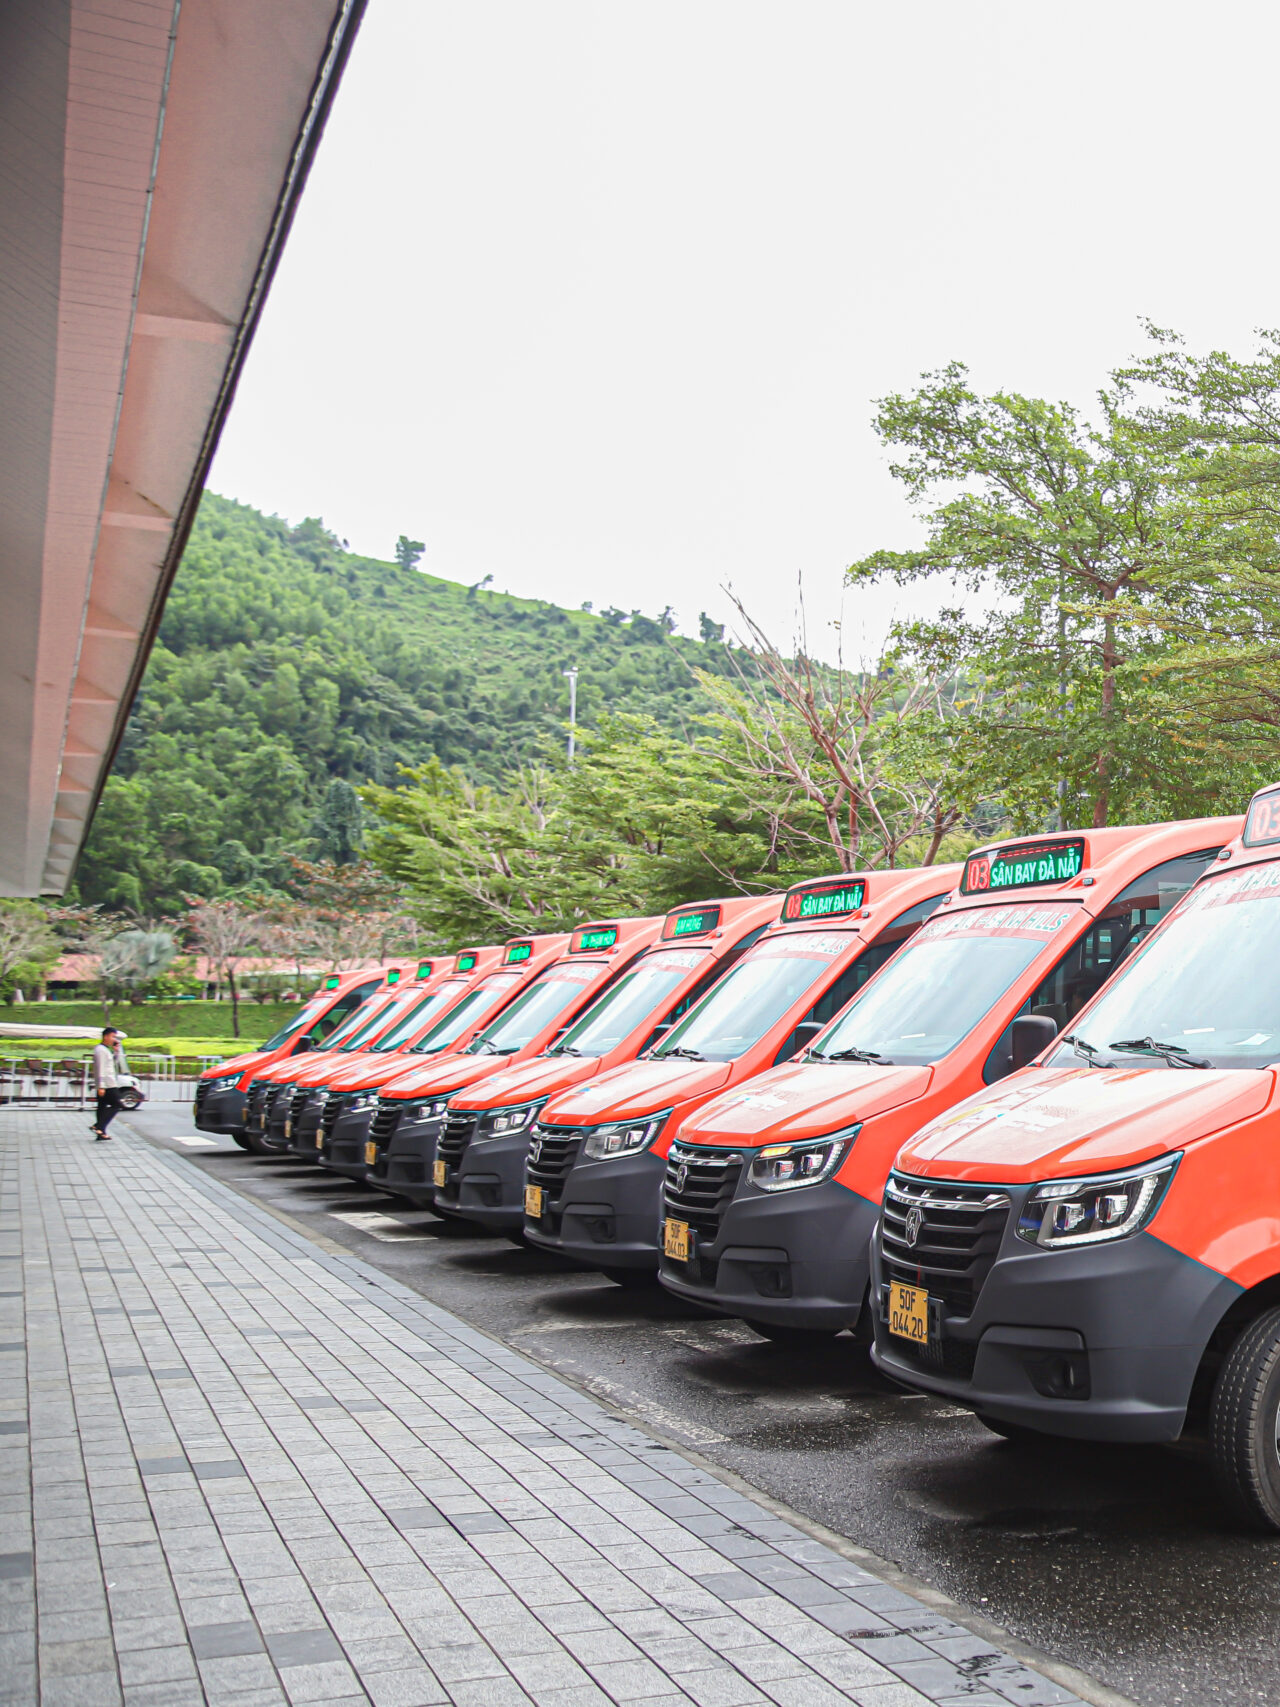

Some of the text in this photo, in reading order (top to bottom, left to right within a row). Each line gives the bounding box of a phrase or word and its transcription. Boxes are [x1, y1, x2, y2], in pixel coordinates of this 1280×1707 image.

[968, 861, 989, 890] 03
[990, 861, 1014, 888] SÂN
[1014, 862, 1037, 884] BAY
[1038, 854, 1056, 880] ĐÀ
[786, 894, 803, 919] 03
[801, 895, 818, 916] SÂN
[818, 896, 834, 914] BAY
[834, 890, 846, 912] ĐÀ
[899, 1288, 916, 1312] 50F
[893, 1311, 923, 1339] 044.20
